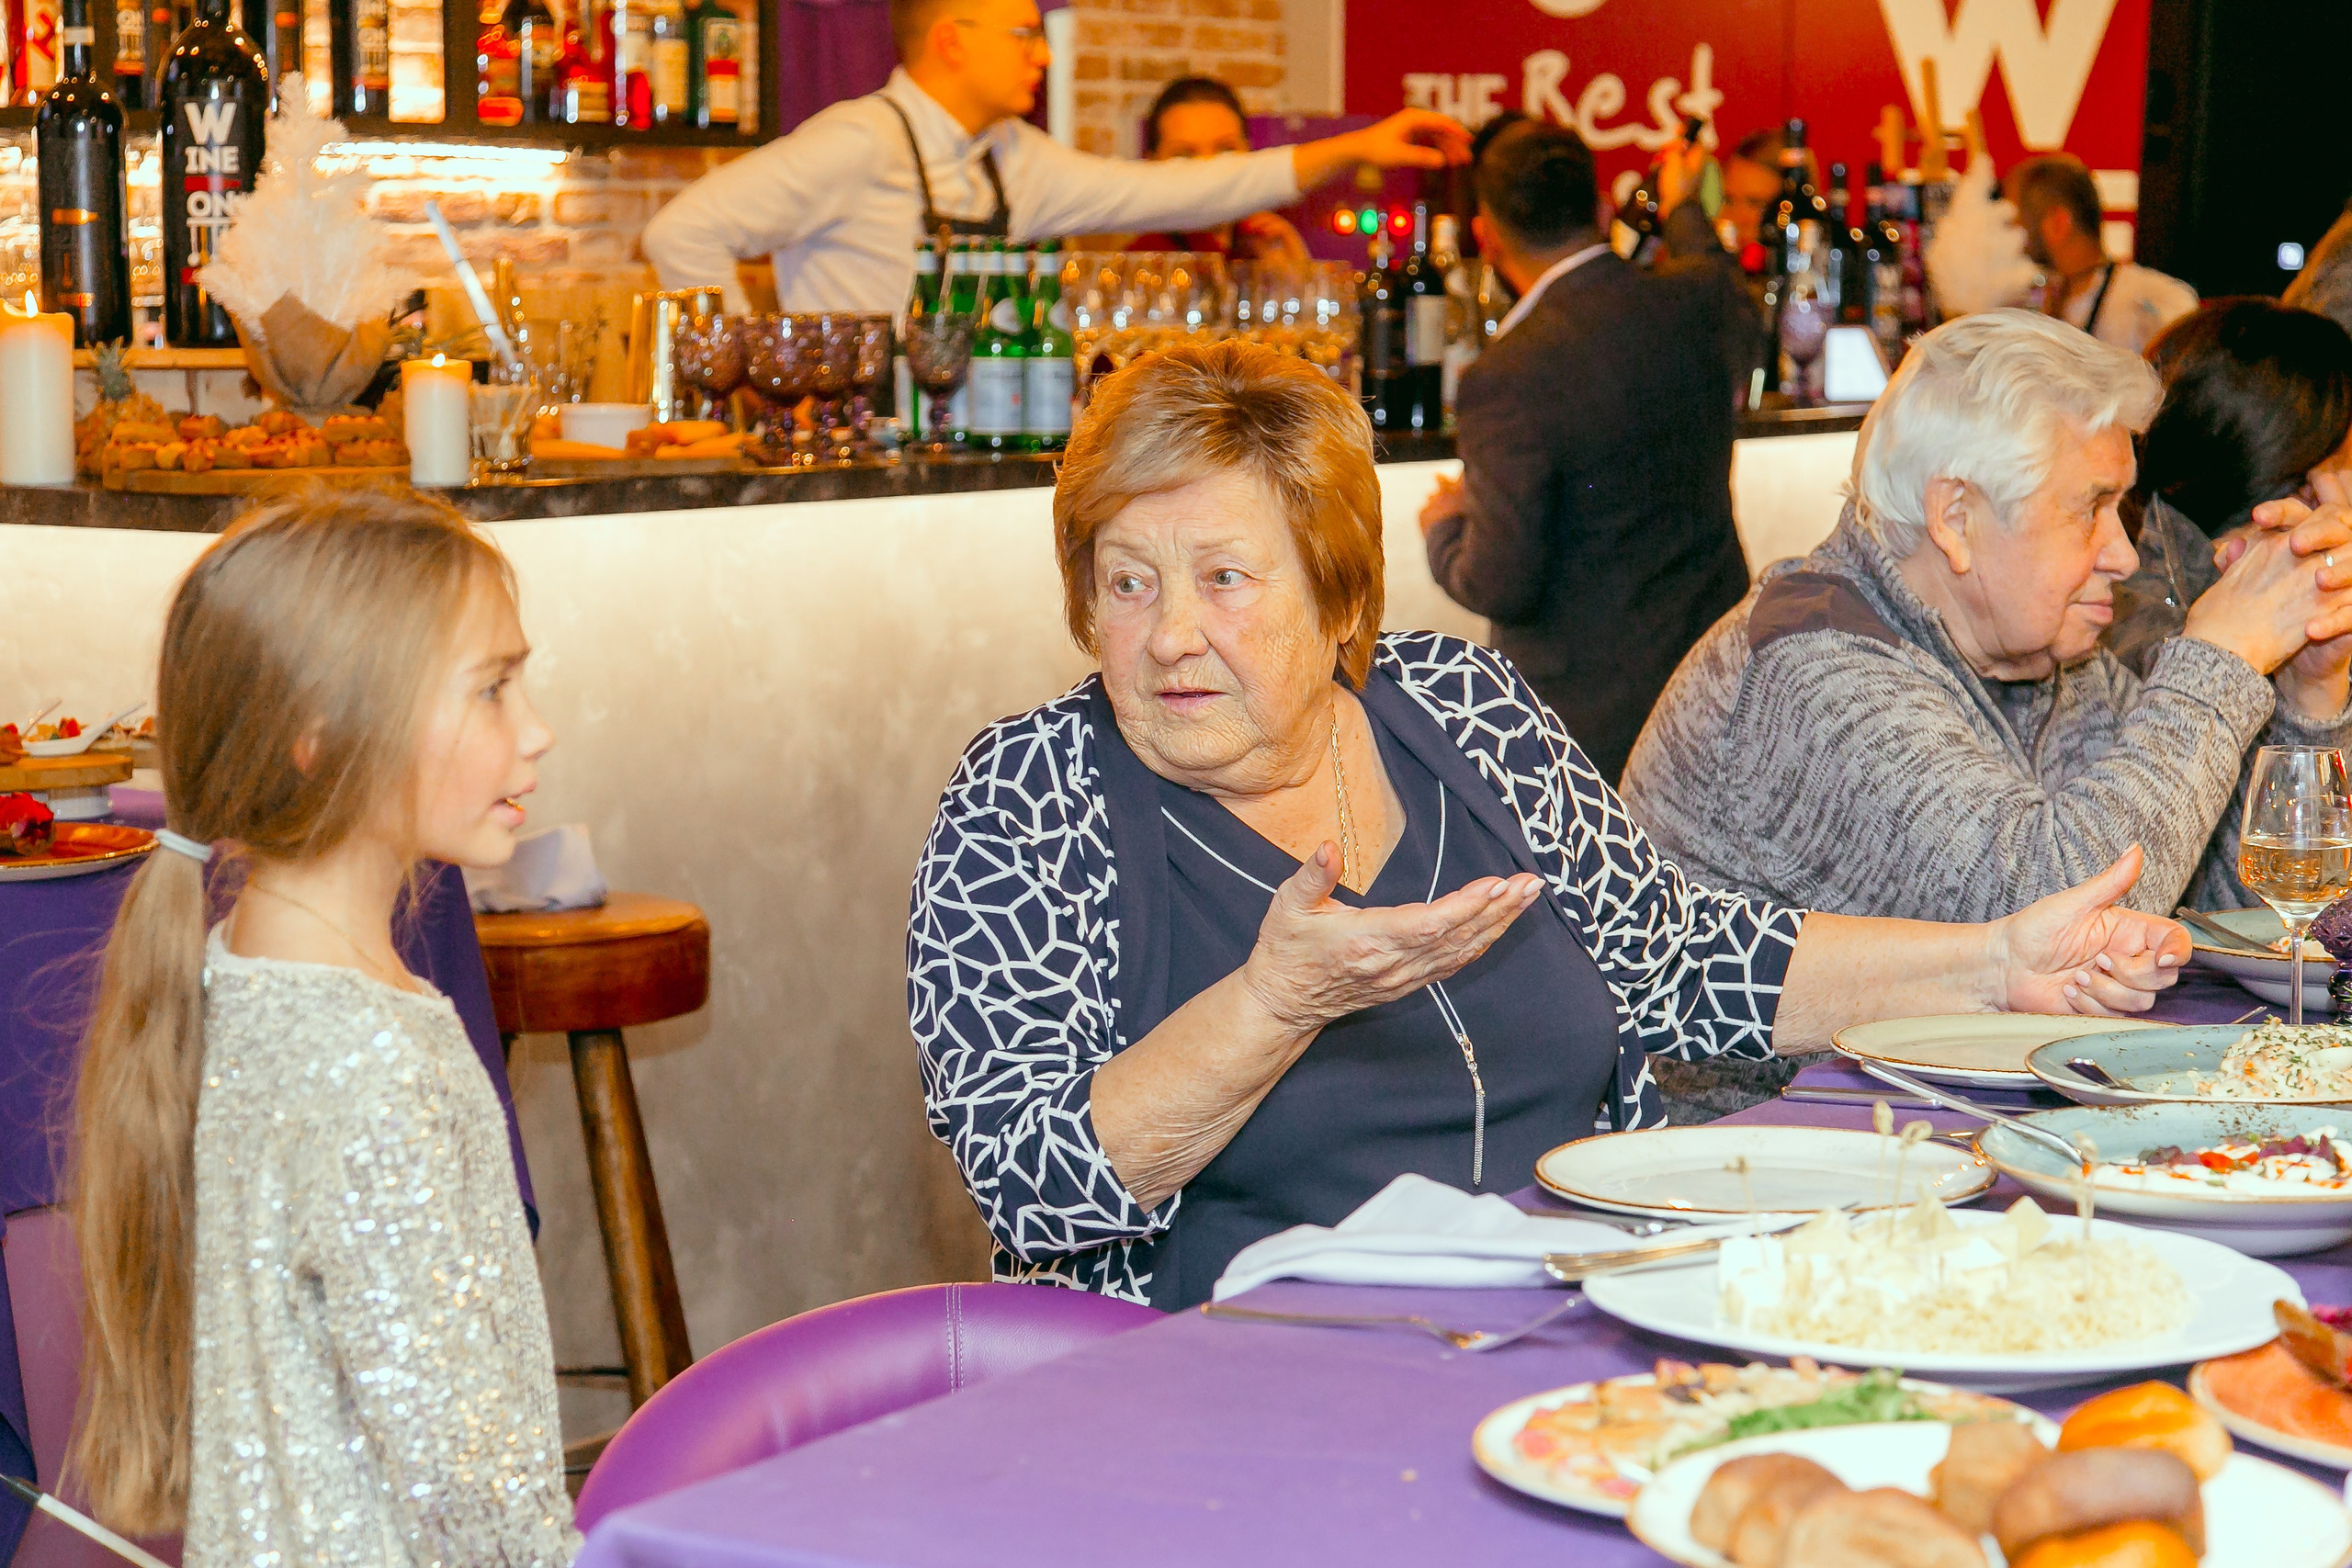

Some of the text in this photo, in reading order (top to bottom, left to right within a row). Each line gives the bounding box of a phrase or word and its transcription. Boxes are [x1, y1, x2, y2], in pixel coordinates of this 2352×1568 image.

[1879, 0, 2118, 152] W
[184, 101, 238, 145] W
[185, 145, 240, 175] INE
